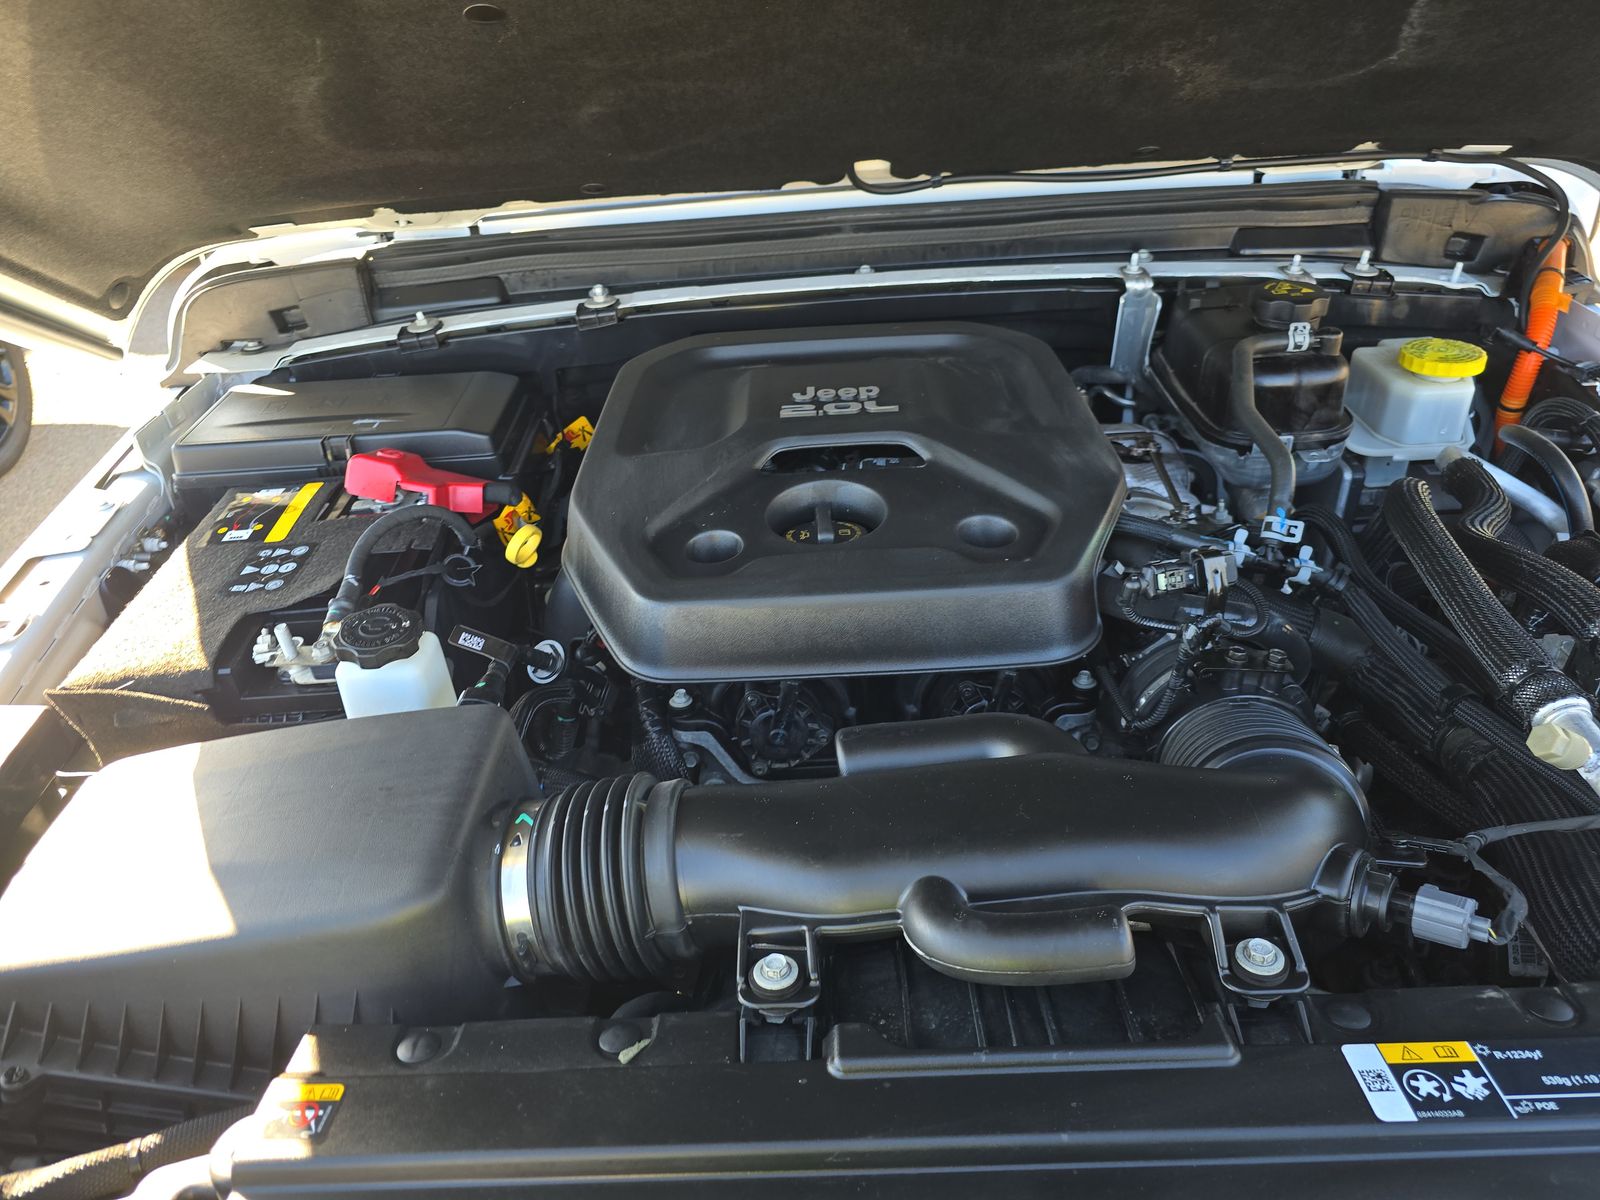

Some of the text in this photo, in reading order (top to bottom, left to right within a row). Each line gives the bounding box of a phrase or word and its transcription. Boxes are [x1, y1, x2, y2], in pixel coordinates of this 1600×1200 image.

[792, 385, 880, 402] Jeep
[780, 401, 899, 418] 2.0L
[1534, 1101, 1560, 1111] POE
